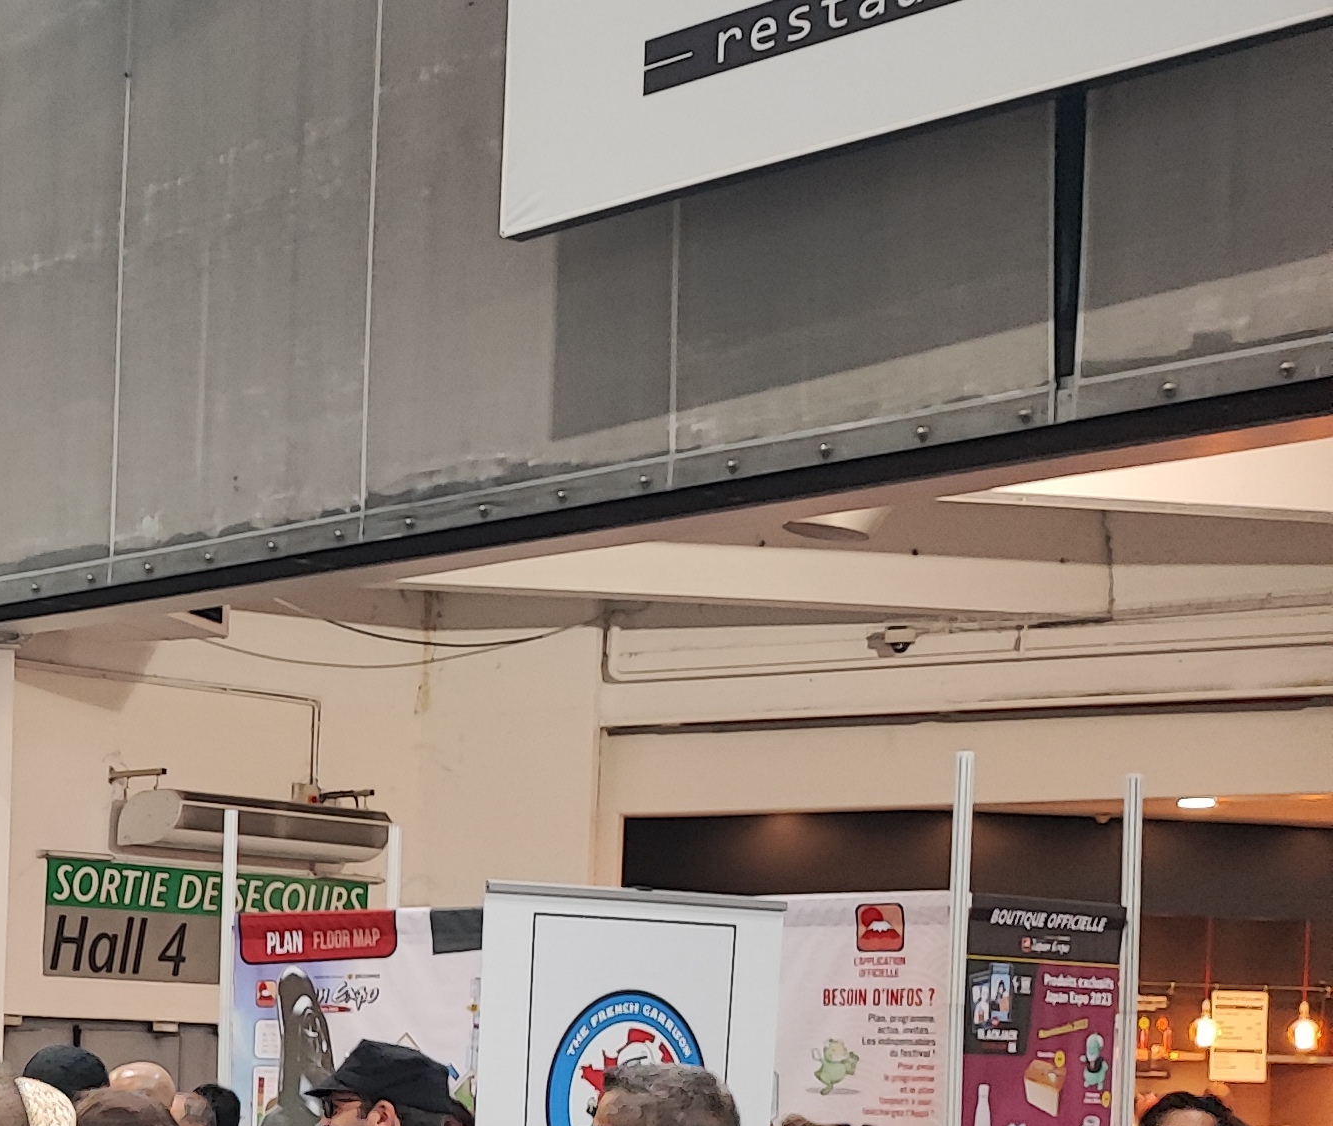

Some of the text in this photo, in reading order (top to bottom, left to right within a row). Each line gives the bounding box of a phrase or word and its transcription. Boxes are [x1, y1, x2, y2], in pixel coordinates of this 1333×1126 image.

[715, 0, 924, 63] resta
[52, 864, 365, 913] SORTIE DE SECOURS
[990, 908, 1108, 933] BOUTIQUE OFFICIELLE
[50, 914, 187, 977] Hall 4
[266, 927, 382, 956] PLAN FLOOR MAP
[823, 987, 936, 1007] BESOIN D'INFOS ?
[1069, 991, 1090, 1007] Expo
[1090, 991, 1113, 1007] 2023
[566, 1002, 692, 1058] THE FRENCH GARRISON
